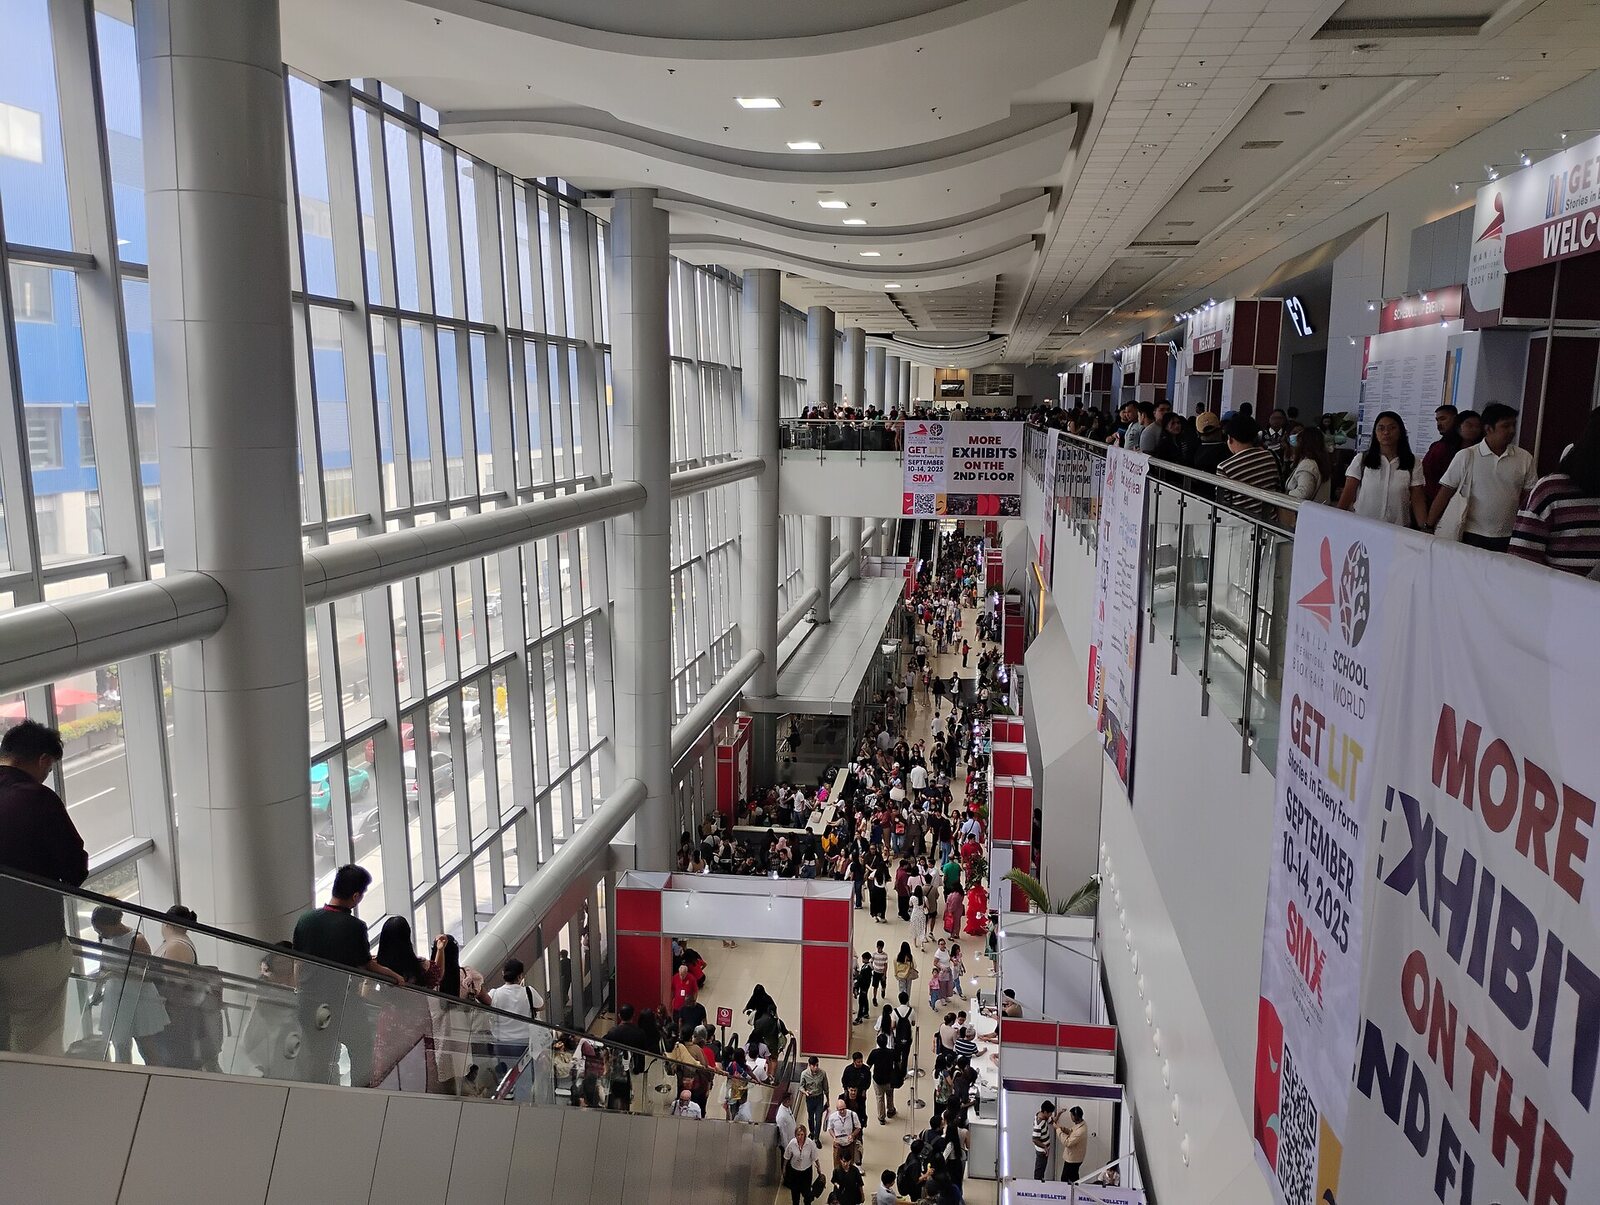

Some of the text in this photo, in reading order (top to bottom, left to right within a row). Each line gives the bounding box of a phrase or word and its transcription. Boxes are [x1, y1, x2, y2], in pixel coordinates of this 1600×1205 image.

[1569, 159, 1600, 194] GE
[1565, 195, 1589, 211] Stories
[1543, 211, 1600, 259] WELC
[1285, 296, 1313, 337] F2
[908, 446, 928, 454] GET
[952, 447, 1018, 459] EXHIBITS
[968, 436, 1002, 445] MORE
[912, 474, 934, 482] SMX
[953, 471, 1015, 481] 2ND FLOOR
[964, 461, 1005, 470] ON THE
[1333, 650, 1369, 691] SCHOOL
[1333, 680, 1366, 720] WORLD
[1291, 693, 1364, 803] GET LIT
[1288, 747, 1360, 841] Stories in Every Form
[1431, 702, 1596, 905] MORE
[1285, 786, 1355, 905] SEPTEMBER
[1283, 831, 1351, 955] 10-14, 2025
[1286, 900, 1327, 1012] SMX
[1352, 1013, 1431, 1158] ND
[1401, 950, 1575, 1205] ON THE
